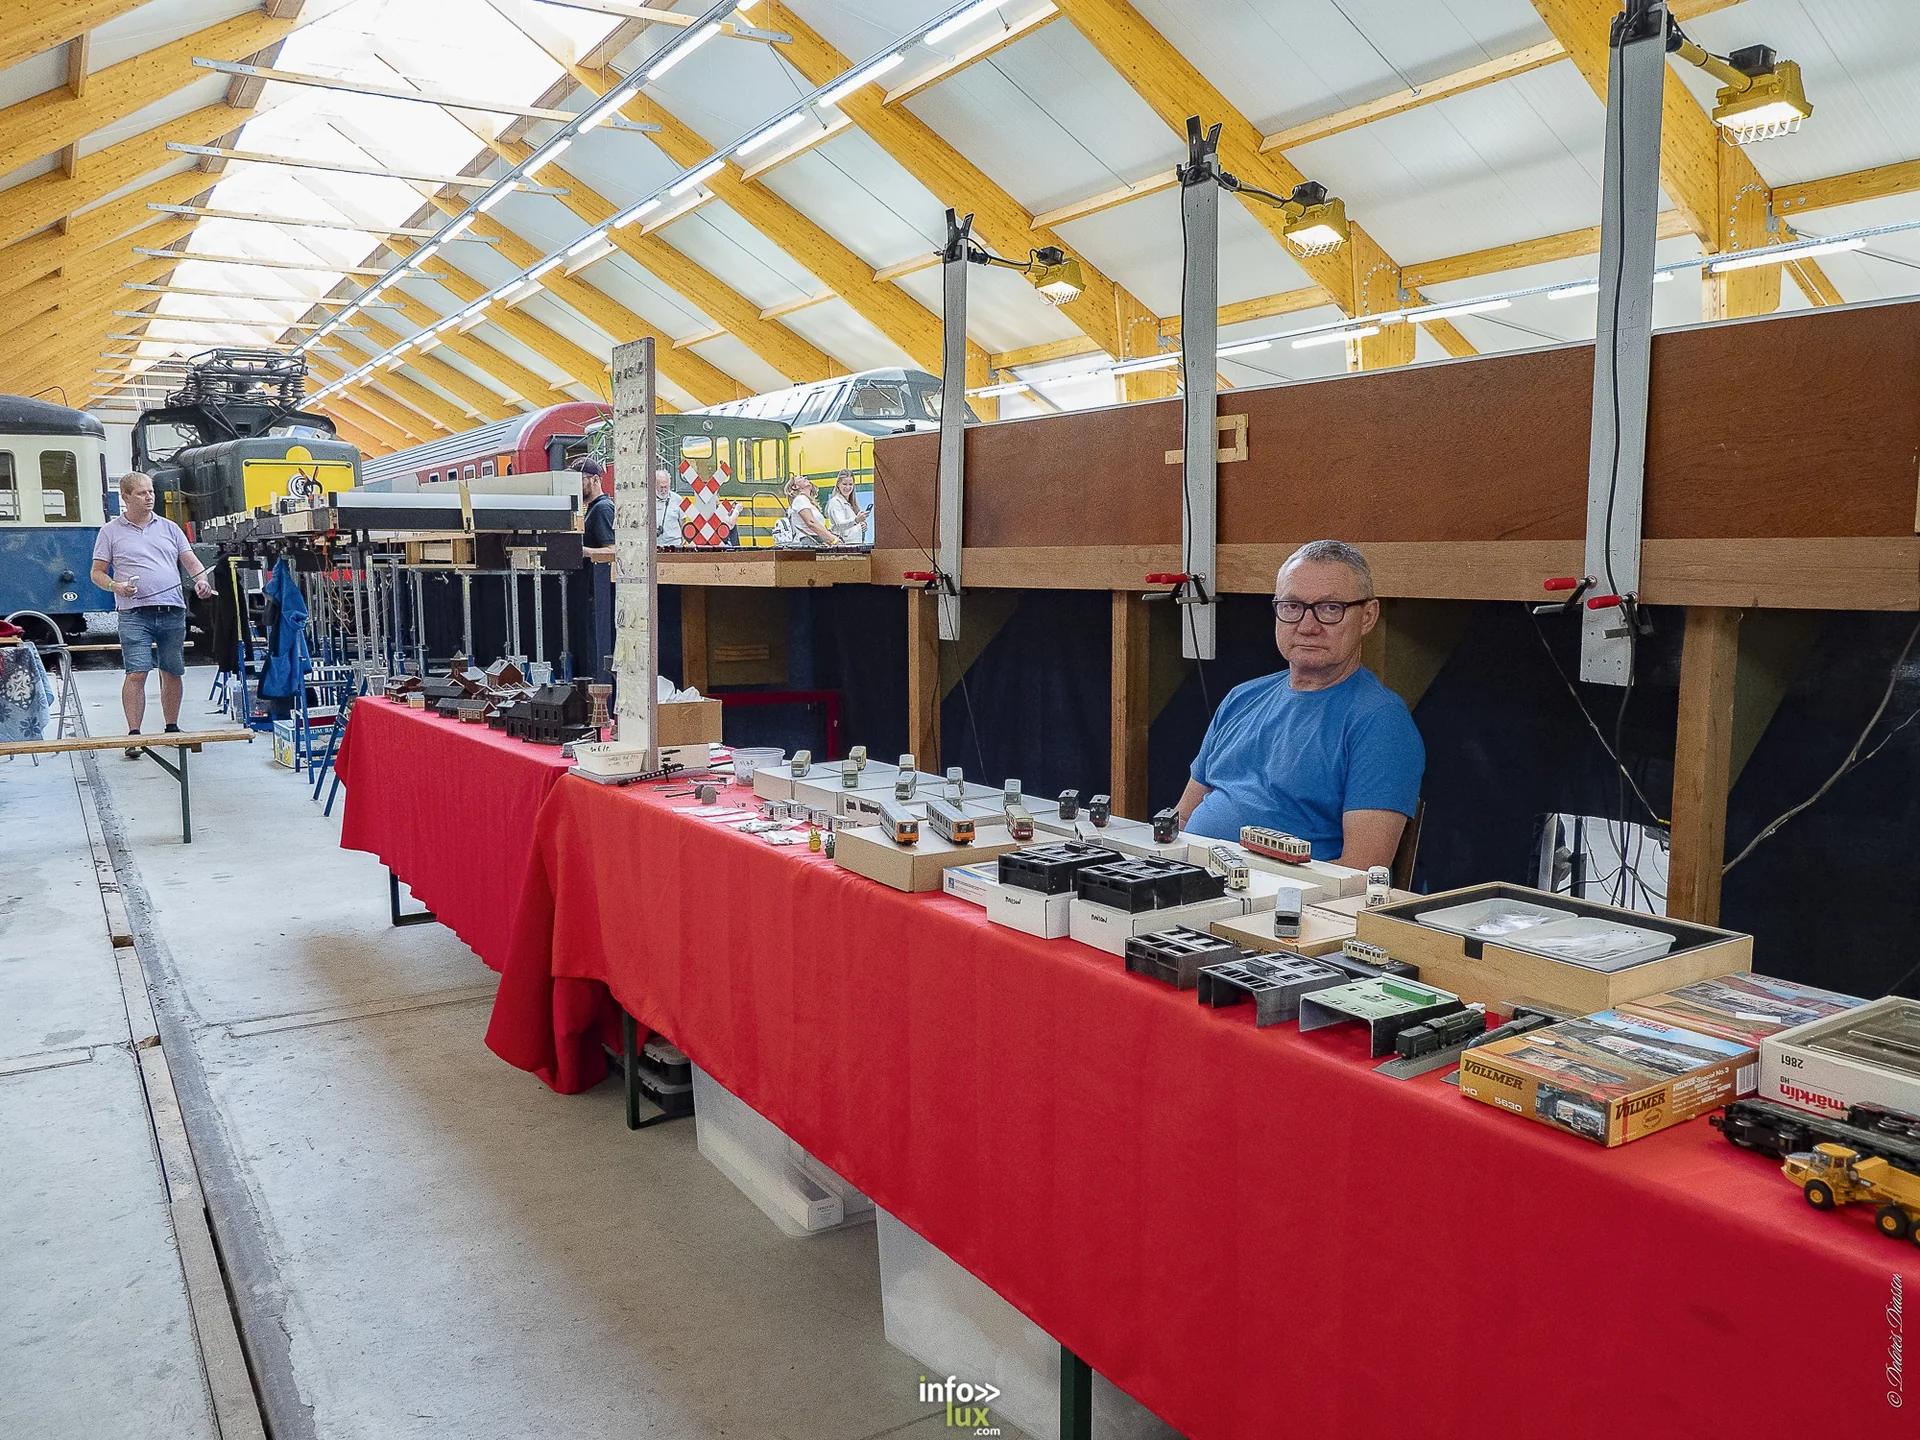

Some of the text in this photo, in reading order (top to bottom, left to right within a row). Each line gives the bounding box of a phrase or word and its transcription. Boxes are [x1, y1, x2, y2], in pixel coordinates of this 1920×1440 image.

[1463, 1058, 1525, 1090] VOLLMER
[1781, 1054, 1804, 1069] 2861
[1494, 1096, 1523, 1112] 5630
[1615, 1088, 1666, 1120] VOLLMER
[1780, 1083, 1844, 1111] märklin
